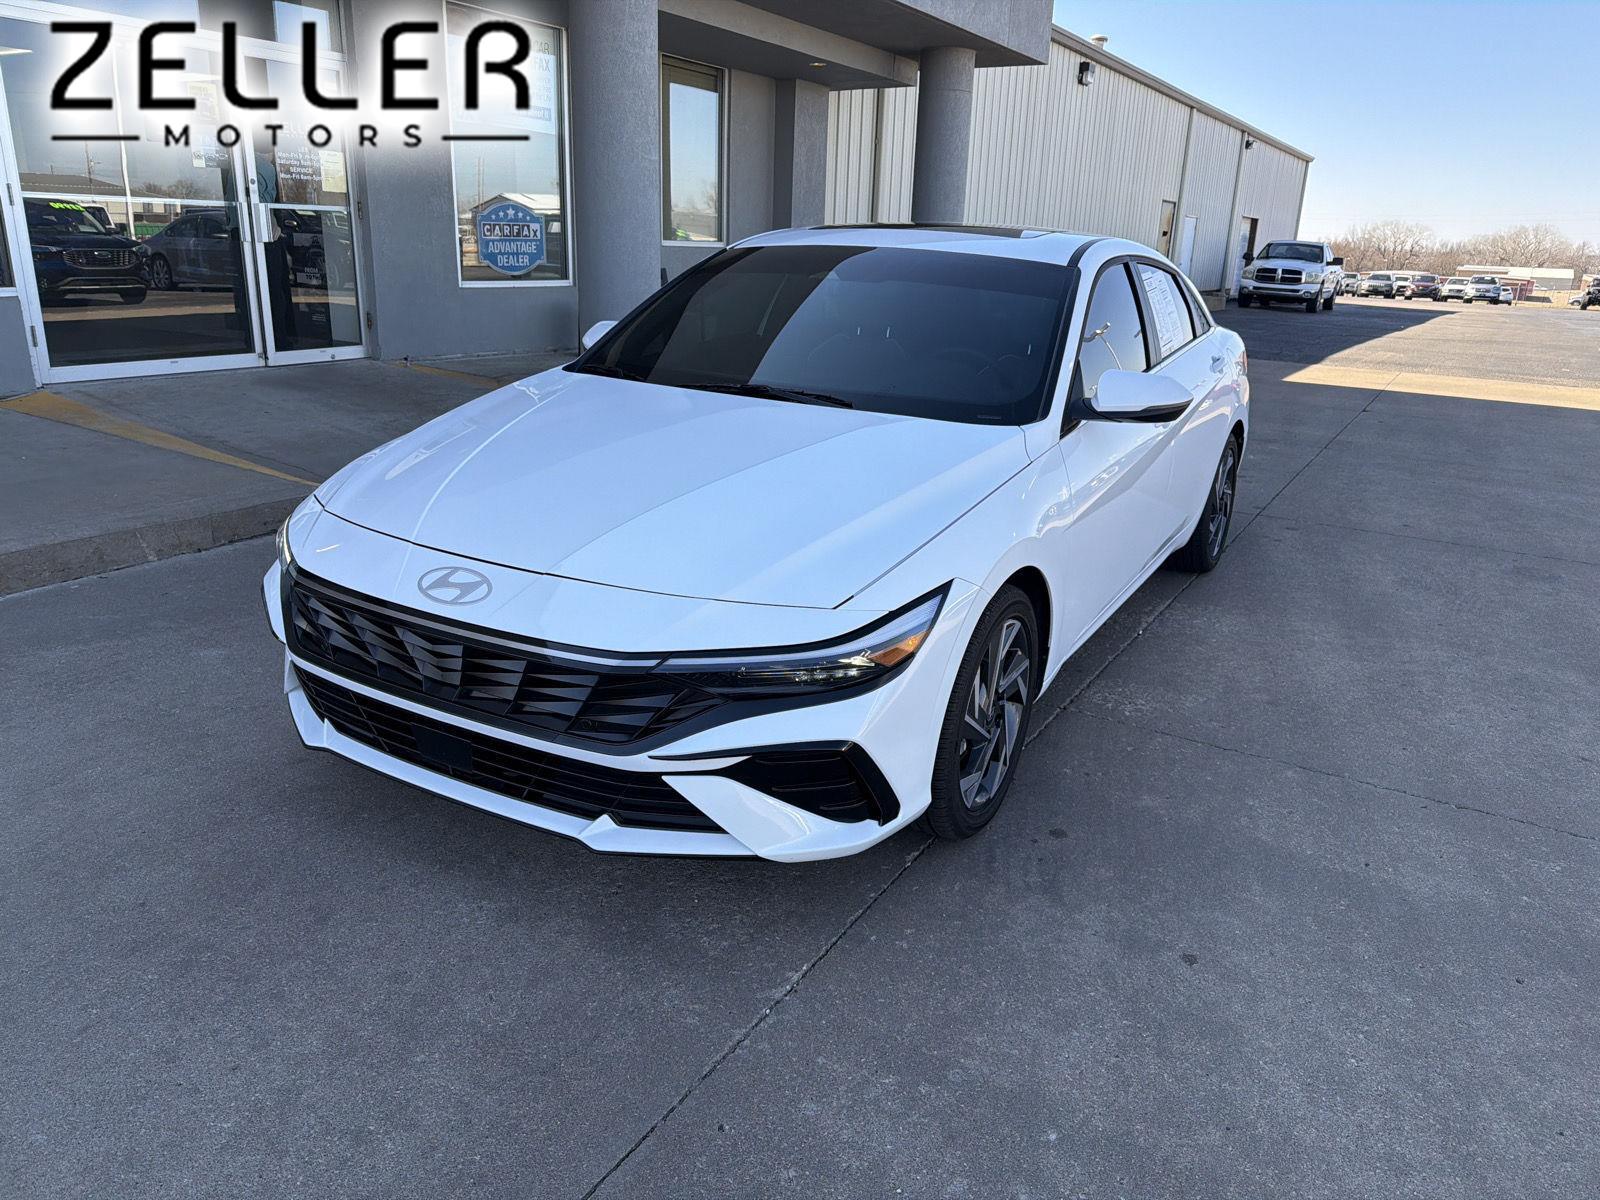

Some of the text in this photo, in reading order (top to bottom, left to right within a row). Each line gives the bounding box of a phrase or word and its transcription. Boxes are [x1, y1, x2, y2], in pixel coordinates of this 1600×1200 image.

[482, 223, 540, 238] CARFAX
[488, 241, 537, 253] ADVANTAGE
[497, 255, 530, 266] DEALER
